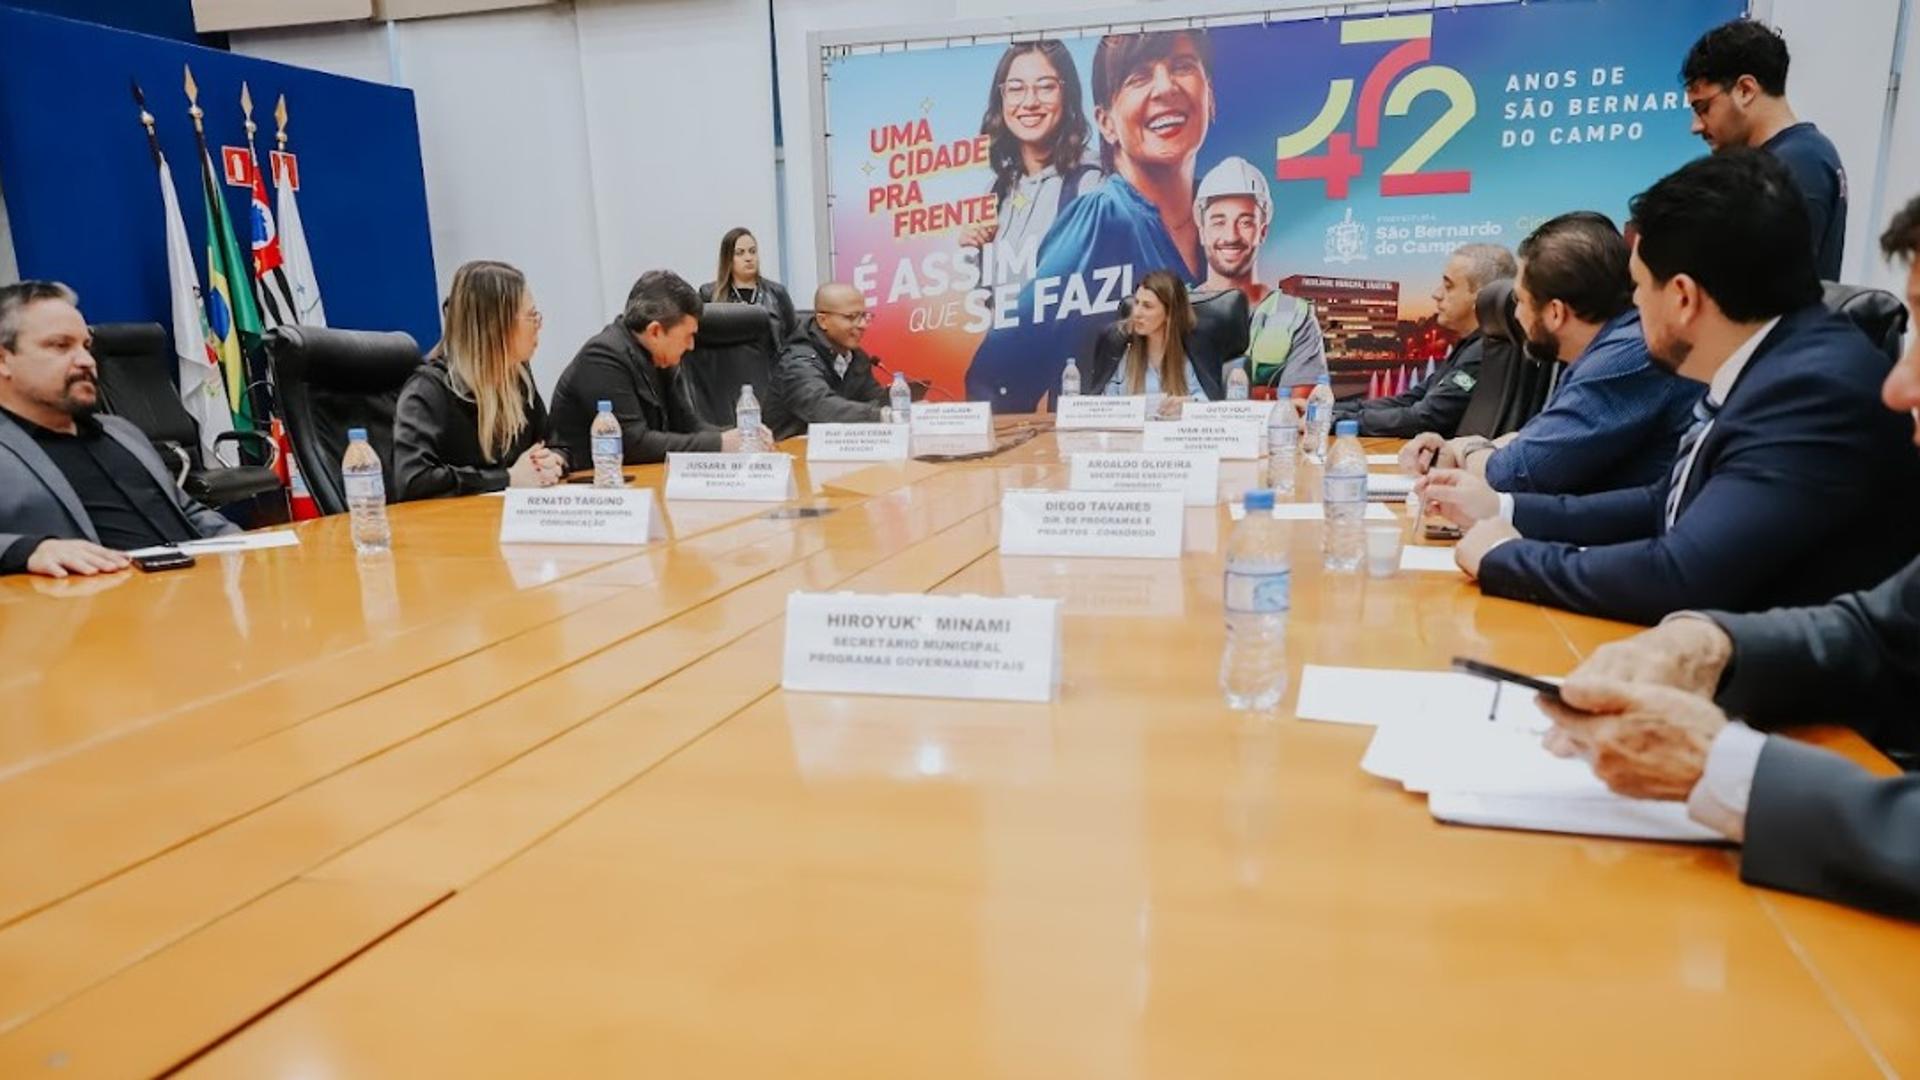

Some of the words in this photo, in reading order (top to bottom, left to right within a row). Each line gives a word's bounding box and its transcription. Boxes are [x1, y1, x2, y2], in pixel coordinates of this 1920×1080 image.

[1505, 70, 1577, 92] ANOS
[1591, 67, 1625, 86] DE
[1504, 98, 1554, 120] SÃO
[870, 118, 933, 154] UMA
[1502, 129, 1535, 148] DO
[1550, 122, 1643, 145] CAMPO
[888, 134, 991, 180] CIDADE
[868, 180, 923, 214] PRA
[894, 194, 997, 238] FRENTE
[1376, 225, 1410, 240] São
[1414, 220, 1502, 239] Bernardo
[1375, 240, 1398, 255] do
[887, 236, 1037, 303] ASSIM
[910, 301, 961, 332] QUE
[963, 284, 1019, 333] SE
[1177, 426, 1199, 434] IVAN
[1201, 426, 1226, 434] SILVA
[686, 461, 727, 471] JUSSARA
[1088, 460, 1139, 470] AROALDO
[1141, 460, 1193, 470] OLIVEIRA
[527, 496, 572, 506] RENATO
[575, 496, 625, 506] TARGINO
[1045, 501, 1086, 512] DIEGO
[1089, 501, 1152, 513] TAVARES
[1065, 516, 1077, 525] DE
[1080, 517, 1142, 526] PROGRAMAS
[1145, 517, 1152, 526] E
[826, 613, 922, 630] HIROYUK
[936, 617, 1012, 633] MINAMI
[923, 638, 1002, 653] MUNICIPAL
[808, 652, 892, 667] PROGRAMAS
[895, 656, 1026, 672] GOVERNAMENTAIS
